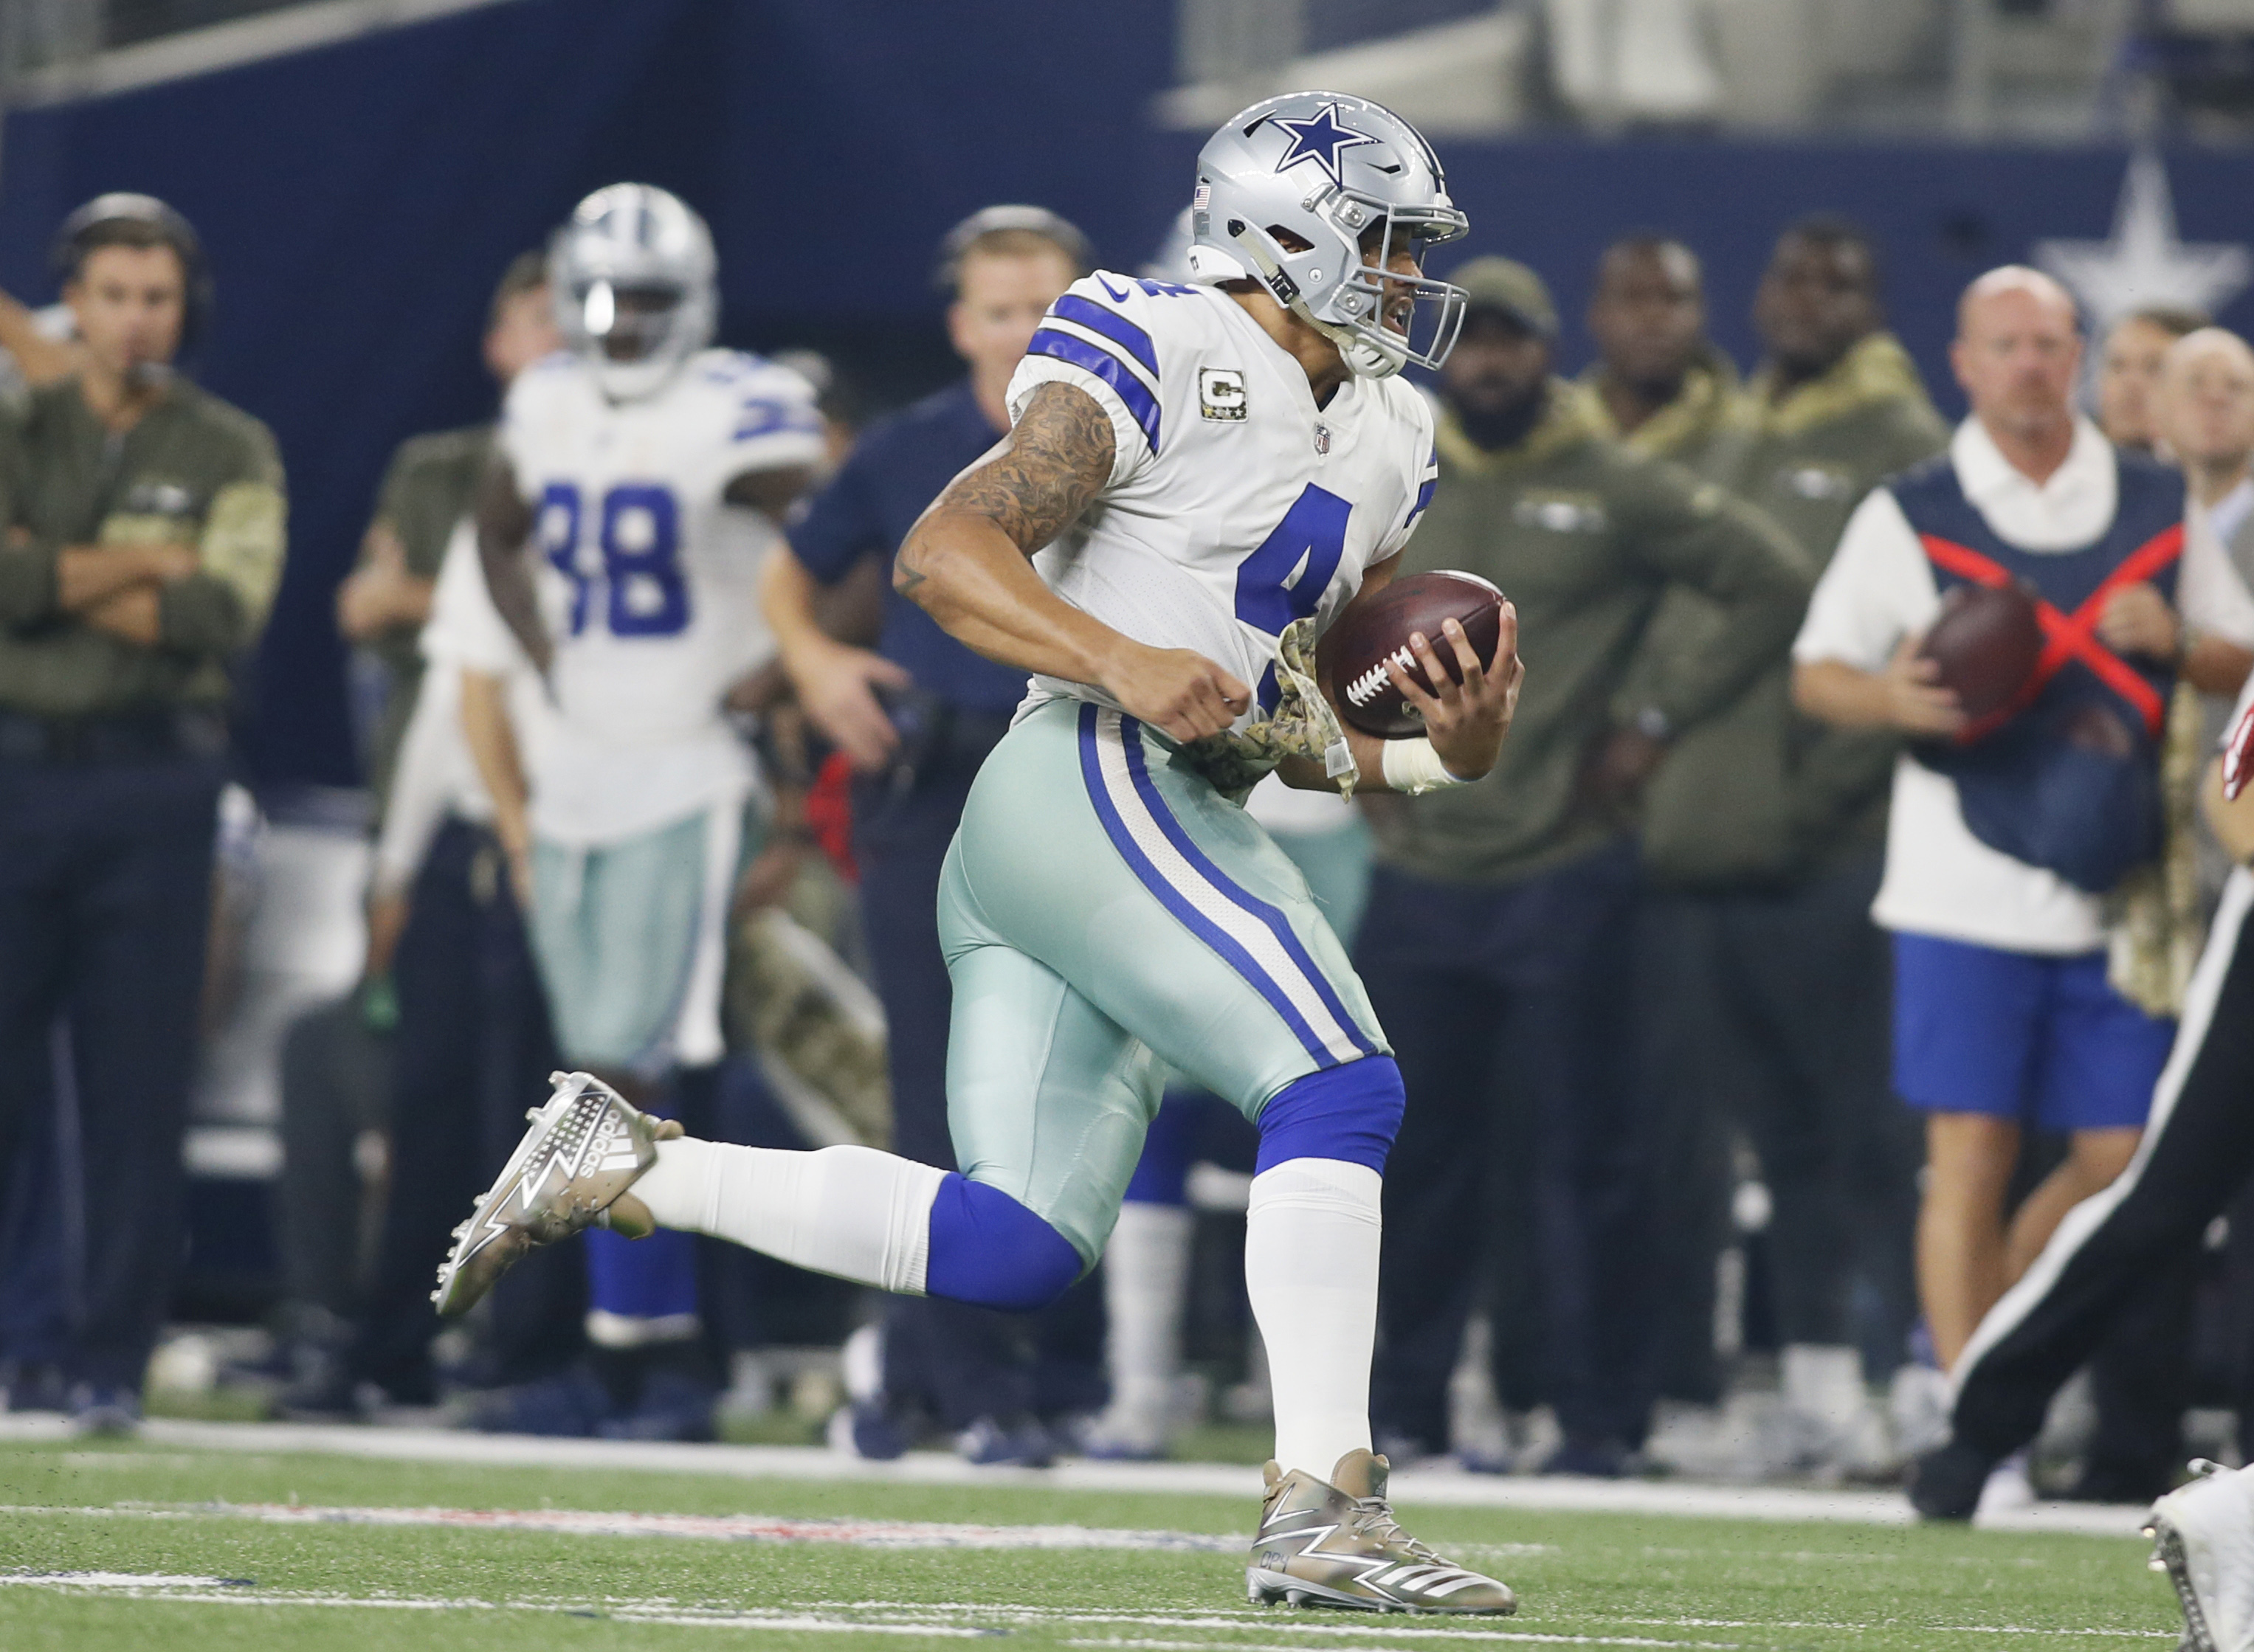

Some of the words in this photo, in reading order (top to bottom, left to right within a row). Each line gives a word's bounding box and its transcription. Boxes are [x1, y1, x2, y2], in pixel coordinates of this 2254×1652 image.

[1202, 370, 1245, 407] C
[1234, 481, 1353, 719] 4
[579, 1109, 621, 1179] adidas
